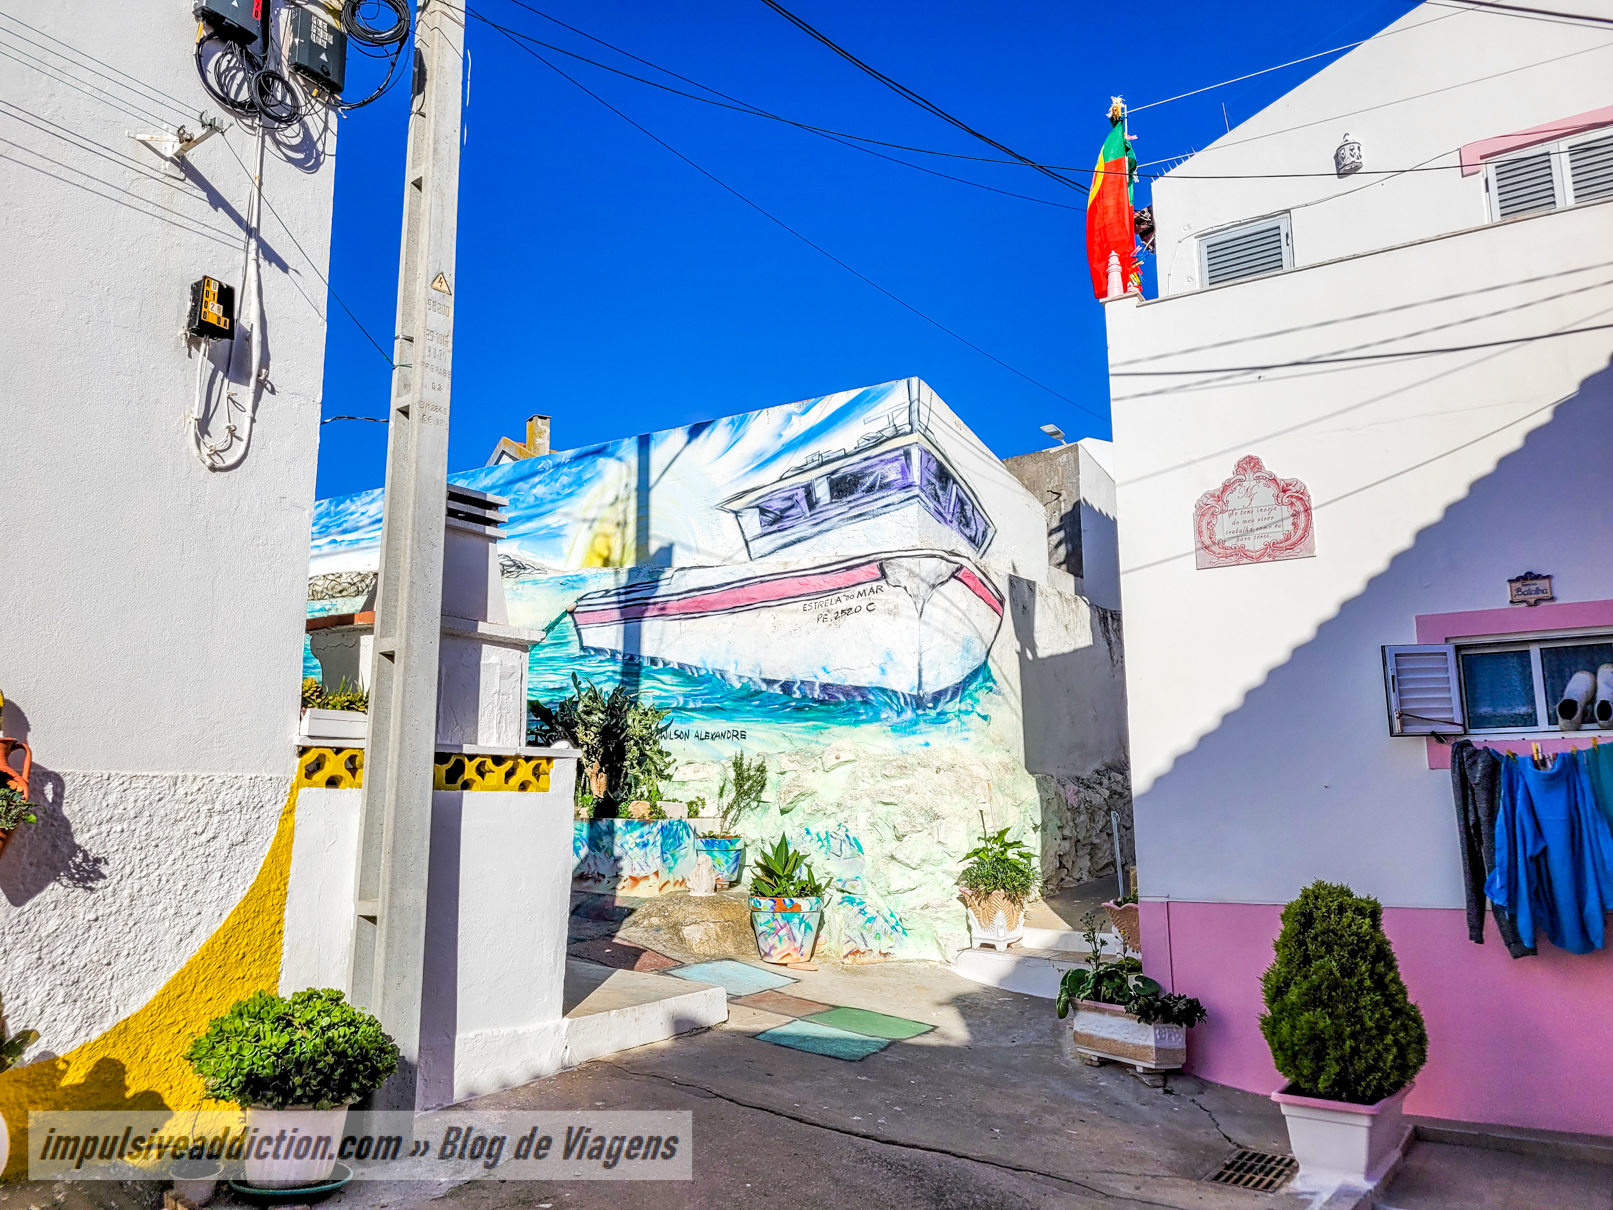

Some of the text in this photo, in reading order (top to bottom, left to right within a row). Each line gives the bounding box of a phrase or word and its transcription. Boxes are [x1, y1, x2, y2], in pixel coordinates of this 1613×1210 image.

[802, 596, 842, 612] ESTRELA
[856, 584, 885, 599] MAR
[1514, 586, 1548, 598] Batalha
[694, 729, 747, 742] ALEXANDRE
